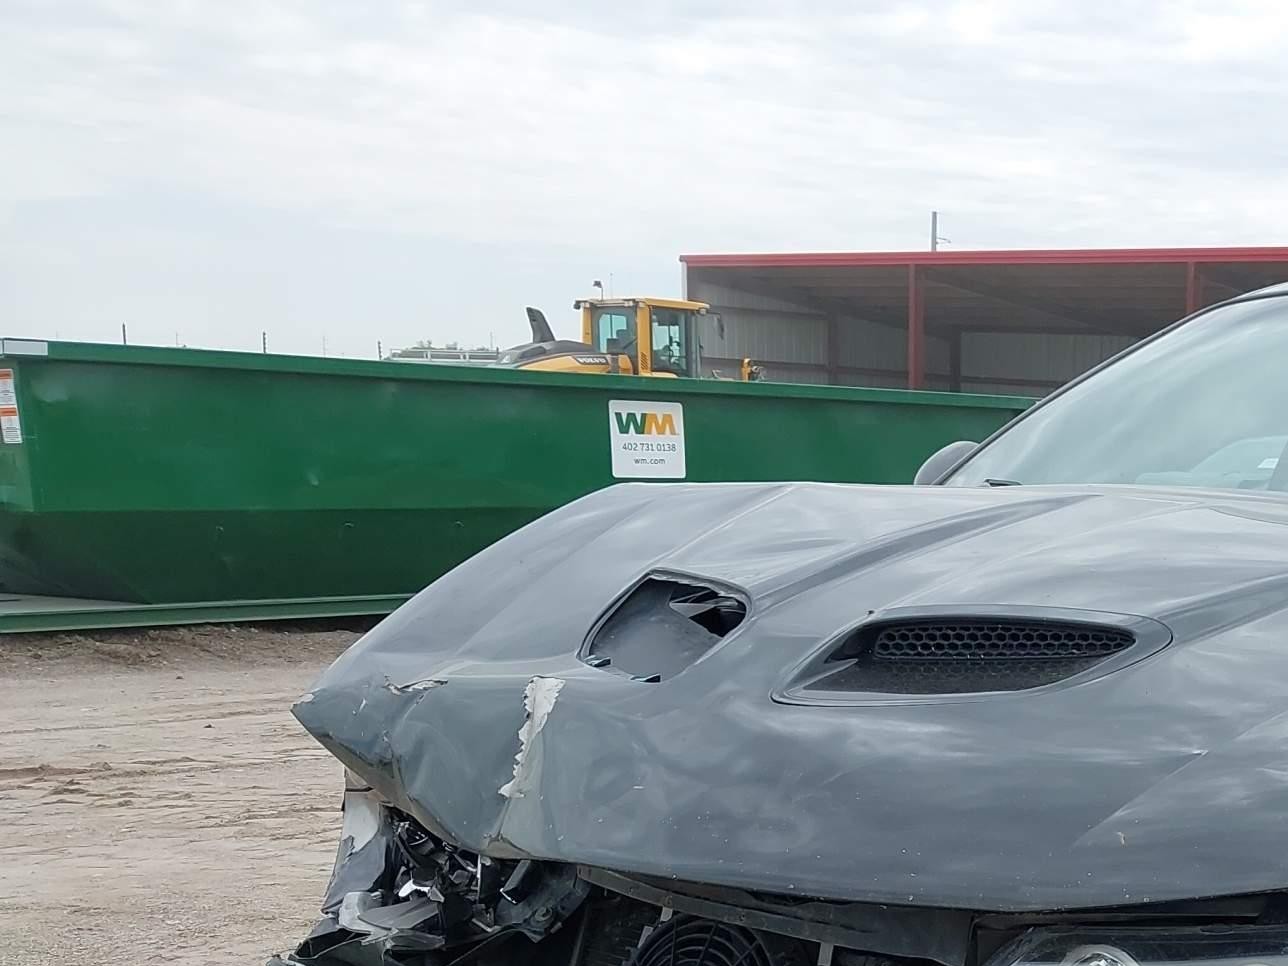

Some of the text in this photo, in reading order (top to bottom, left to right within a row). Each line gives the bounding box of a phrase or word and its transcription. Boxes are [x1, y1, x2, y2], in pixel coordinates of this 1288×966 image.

[614, 412, 677, 436] WM
[622, 442, 677, 453] 402 731 0138
